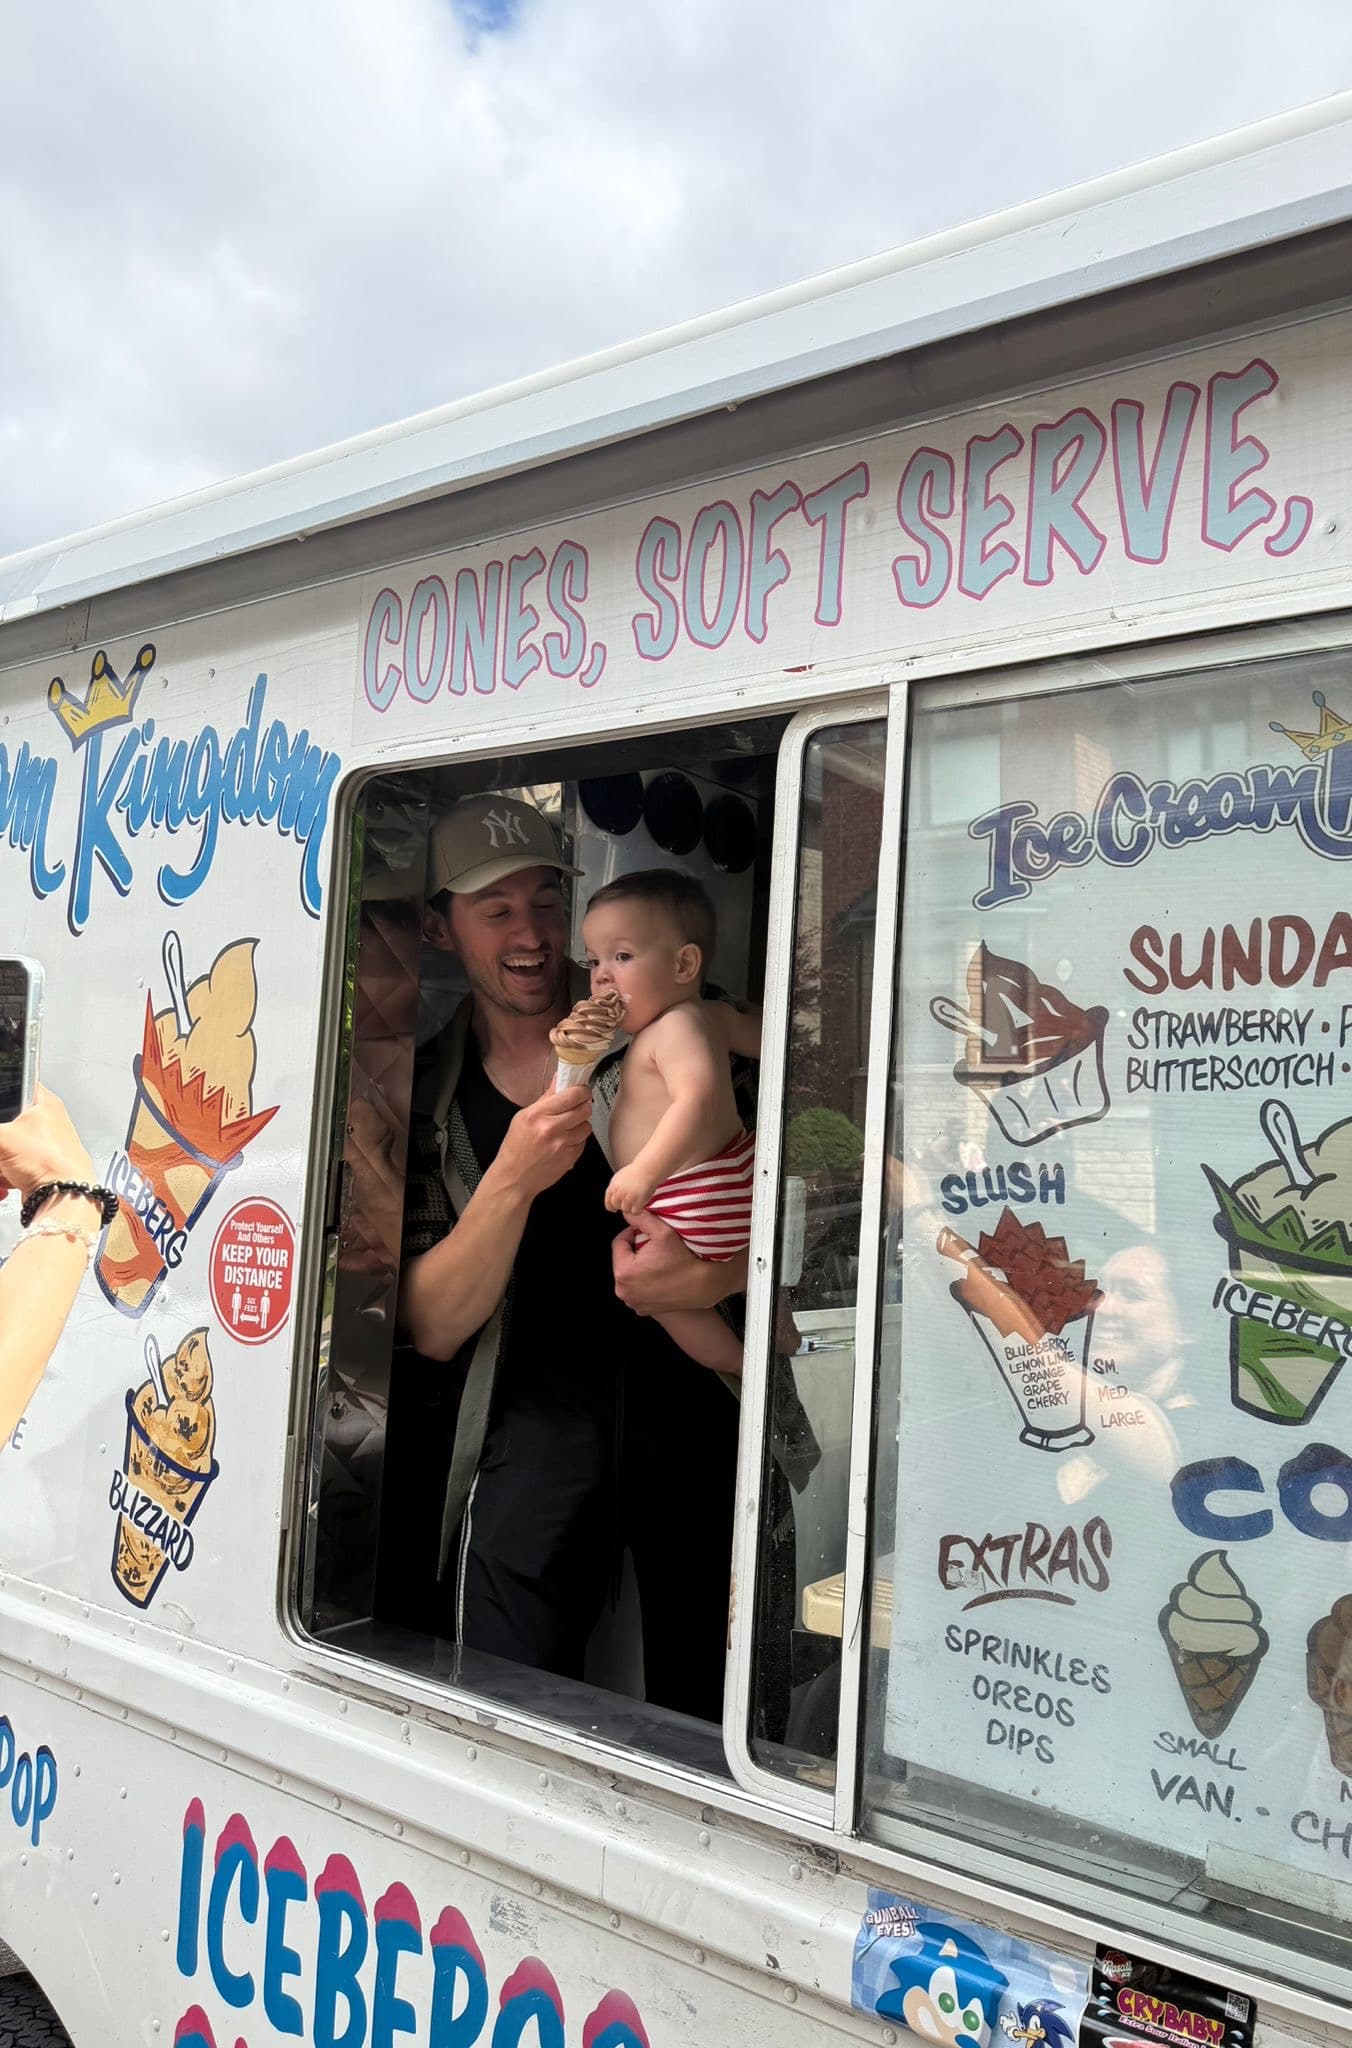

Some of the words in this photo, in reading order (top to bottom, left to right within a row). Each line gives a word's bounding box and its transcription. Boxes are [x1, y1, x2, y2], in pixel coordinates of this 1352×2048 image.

[362, 538, 606, 714] CONES,
[632, 460, 871, 662] SOFT
[893, 357, 1314, 609] SERVE,
[68, 673, 341, 937] Kingdom
[482, 808, 530, 848] NY
[1127, 1006, 1314, 1049] STRAWBERRY
[1127, 1050, 1335, 1093] BUTTERSCOTCH
[940, 1162, 1066, 1215] SLUSH
[104, 1150, 188, 1270] ICEBERG
[230, 1220, 255, 1231] Protect
[256, 1221, 284, 1234] Yourself
[237, 1232, 251, 1243] And
[251, 1232, 275, 1245] Others
[222, 1243, 253, 1264] KEEP
[256, 1246, 288, 1268] YOUR
[224, 1265, 283, 1290] DISTANCE
[1004, 1337, 1071, 1361] BLUEBERRY
[1009, 1355, 1045, 1374] LEMON
[1046, 1350, 1076, 1366] LIME
[1093, 1358, 1120, 1375] SM.
[1021, 1366, 1066, 1384] ORANGE
[1023, 1379, 1062, 1397] GRAPE
[1027, 1391, 1070, 1410] CHERRY
[1098, 1385, 1130, 1402] MED.
[1101, 1410, 1146, 1428] LARGE
[109, 1470, 195, 1573] BLIZZARD
[937, 1515, 1112, 1593] EXTRAS
[944, 1624, 1112, 1694] SPRINKLES
[972, 1675, 1075, 1728] OREOS
[986, 1718, 1055, 1764] DIPS
[1152, 1730, 1247, 1772] SMALL
[866, 1904, 921, 1925] GUMBALL
[877, 1921, 915, 1937] EYES!
[1118, 2015, 1144, 2031] Extra
[1145, 2025, 1169, 2039] Sour
